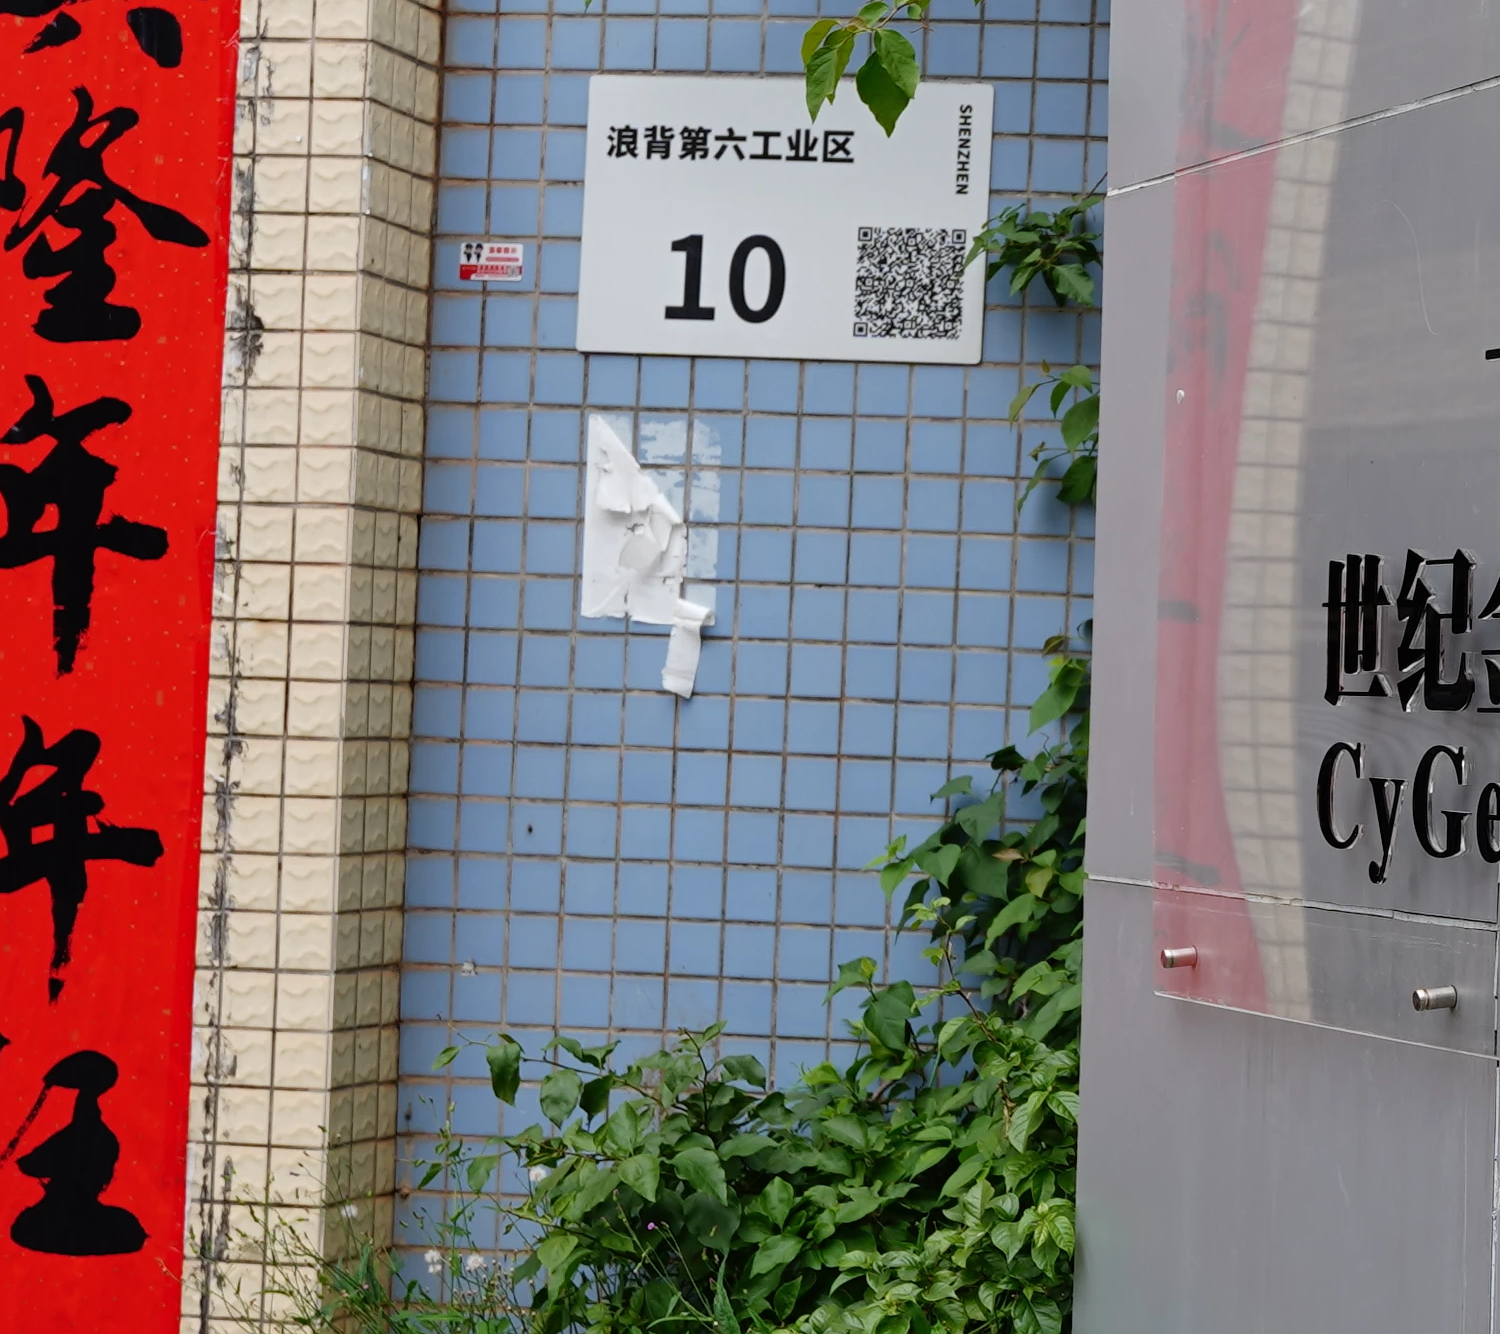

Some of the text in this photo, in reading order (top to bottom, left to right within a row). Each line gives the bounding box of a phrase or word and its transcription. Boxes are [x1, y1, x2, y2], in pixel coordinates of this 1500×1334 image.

[606, 124, 855, 164] 浪背第六工业区
[954, 104, 974, 196] SHENZHEN
[664, 234, 787, 324] 10
